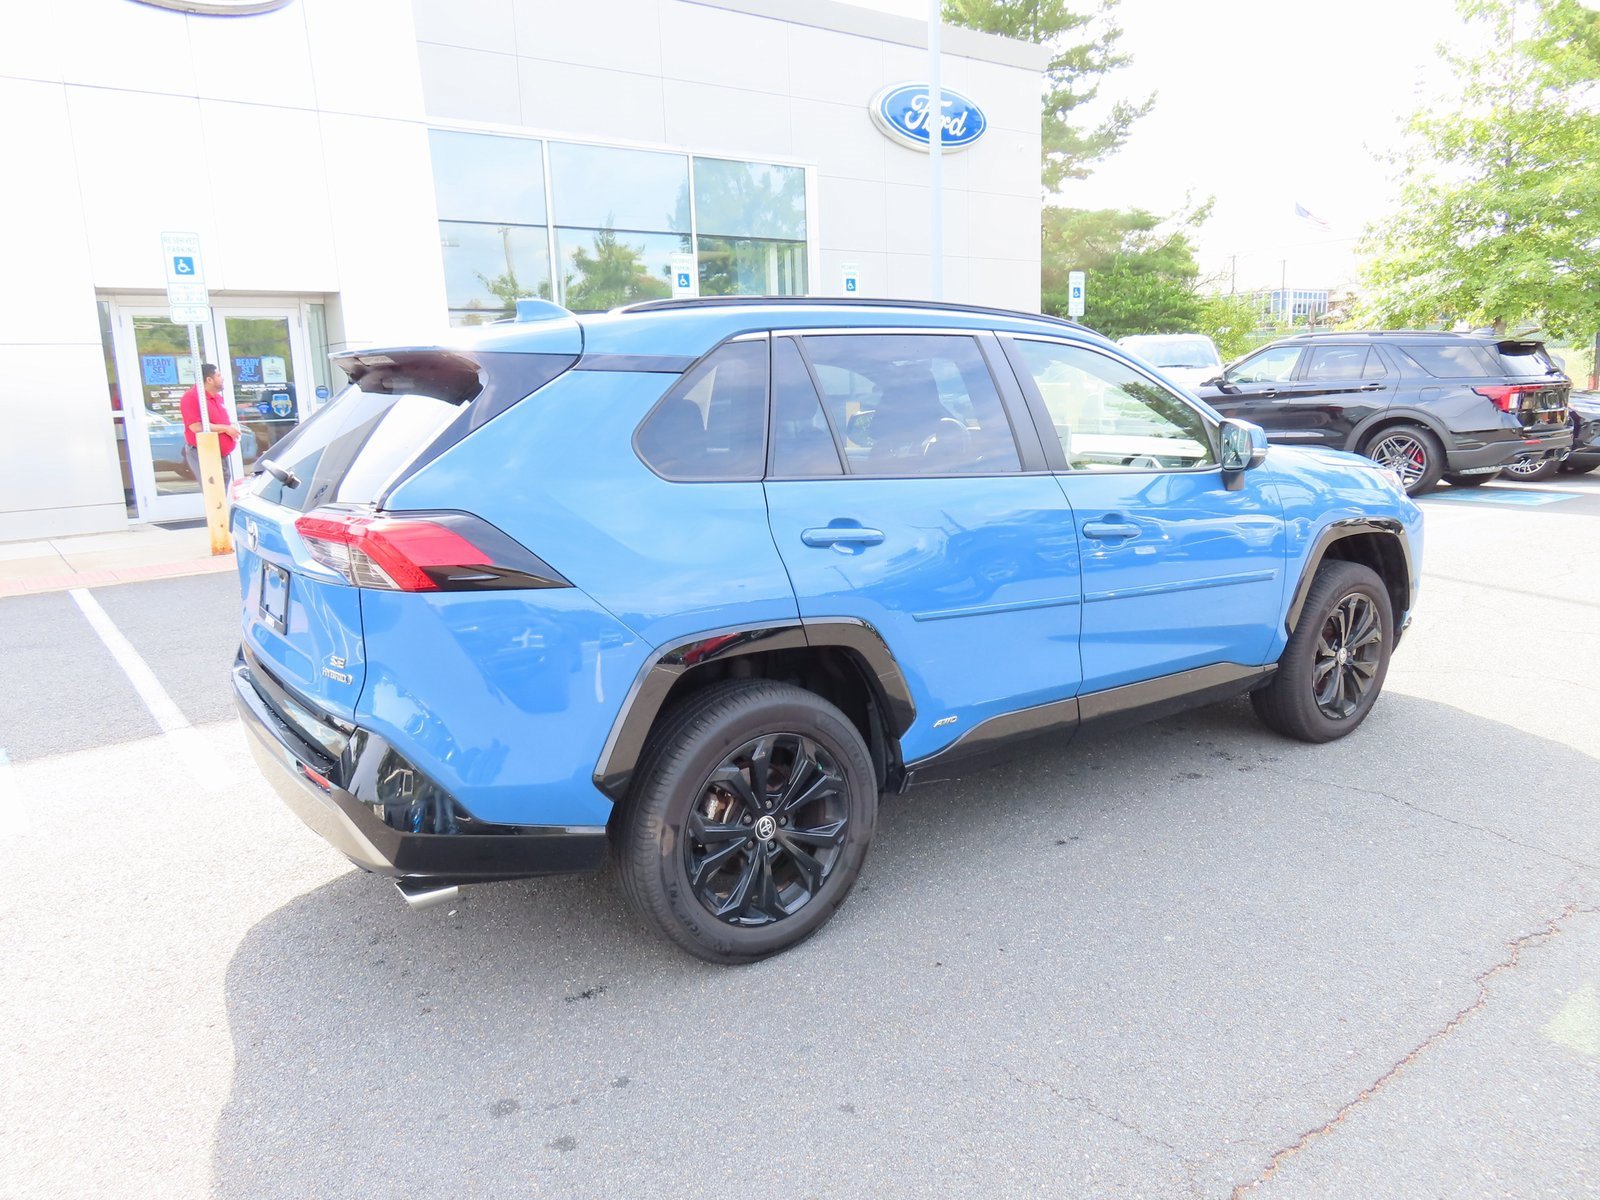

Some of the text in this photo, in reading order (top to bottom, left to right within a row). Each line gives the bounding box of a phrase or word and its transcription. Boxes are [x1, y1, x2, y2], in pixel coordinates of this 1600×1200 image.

[166, 246, 197, 254] PARKING
[146, 358, 171, 367] READY
[235, 358, 259, 367] READY
[241, 366, 255, 374] SET
[238, 373, 260, 382] Ford
[322, 666, 347, 684] HYBRID
